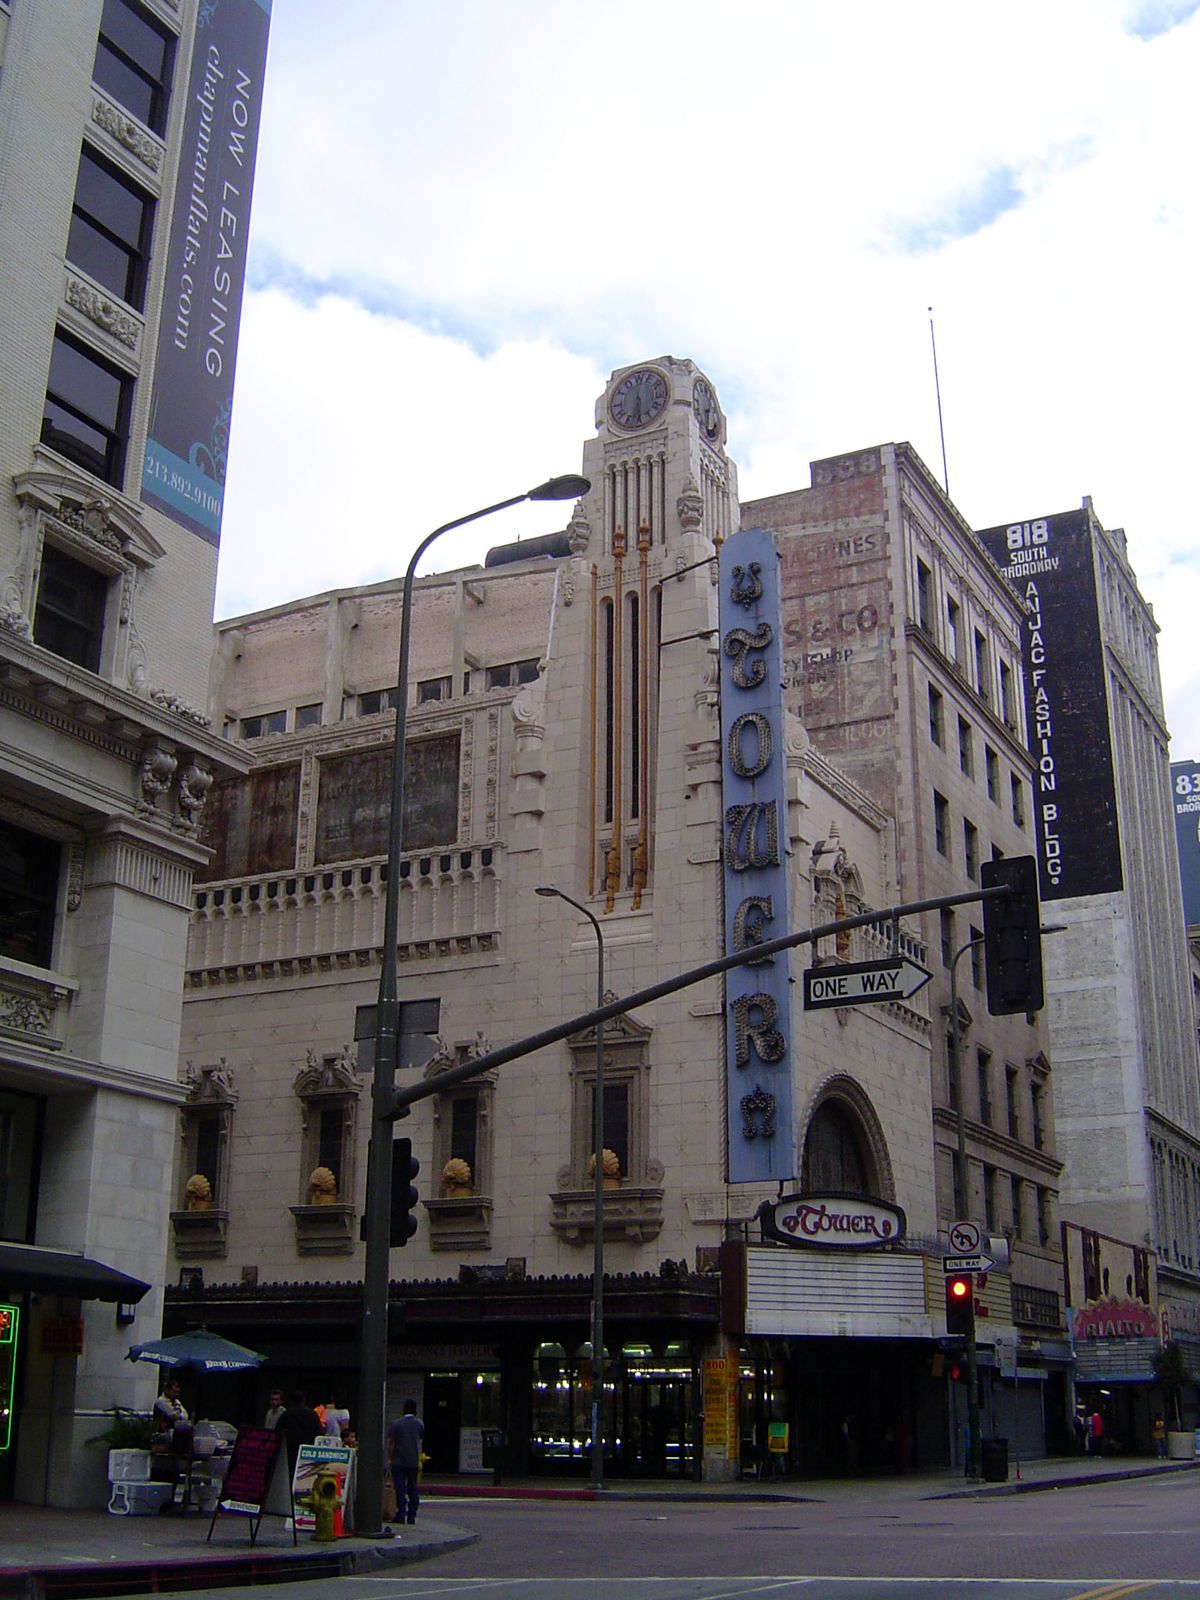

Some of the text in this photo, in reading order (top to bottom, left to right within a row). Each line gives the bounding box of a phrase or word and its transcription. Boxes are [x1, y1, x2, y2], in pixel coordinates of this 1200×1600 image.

[173, 45, 222, 352] chapmanflats.com
[205, 68, 252, 378] NOW LEASING
[146, 455, 221, 516] 213.892.9100
[1006, 520, 1049, 550] 818
[1010, 546, 1048, 565] SOUTH
[1031, 669, 1056, 792] FASHION
[812, 970, 900, 999] ONE WAY
[1086, 1319, 1146, 1337] RIALTO
[705, 1360, 725, 1370] 800
[301, 1449, 348, 1460] COLD SANDWICH
